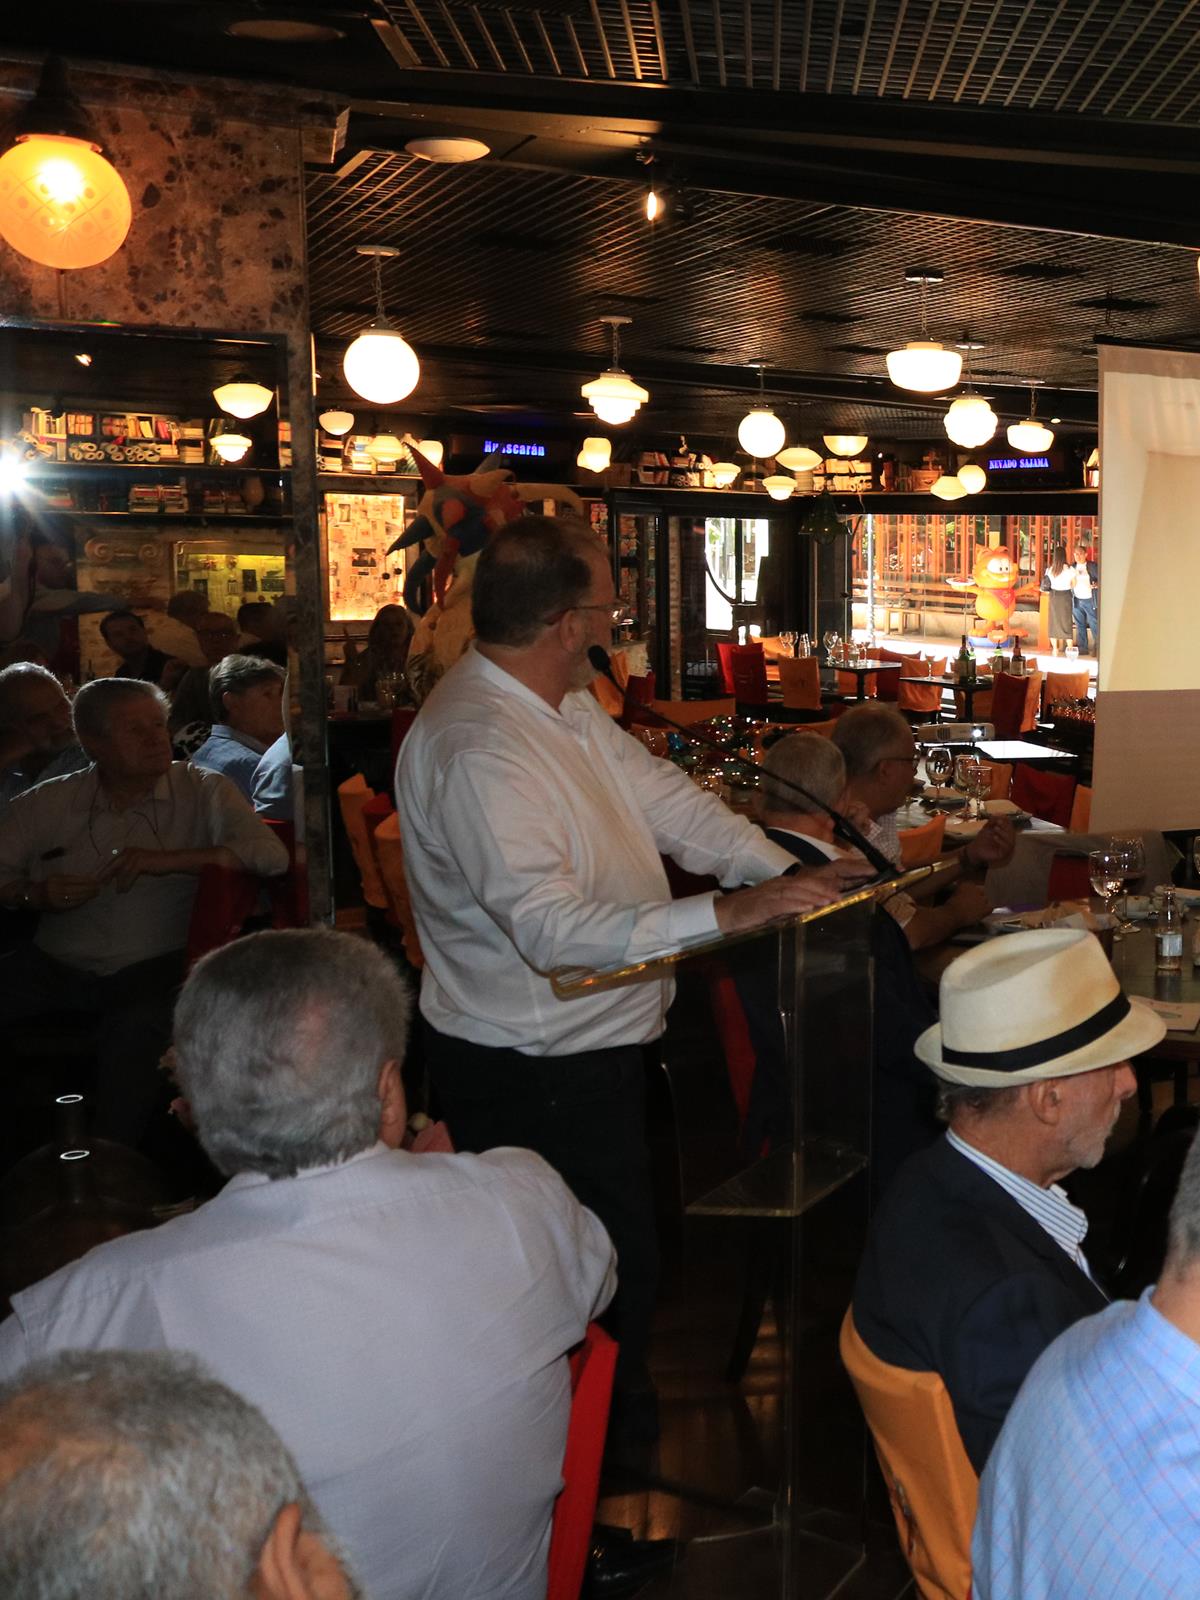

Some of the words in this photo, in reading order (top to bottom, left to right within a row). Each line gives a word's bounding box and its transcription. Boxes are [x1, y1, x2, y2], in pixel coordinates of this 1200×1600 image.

[484, 440, 545, 457] Huscarán
[988, 459, 1018, 470] NEVADO
[1019, 458, 1049, 469] SAJAMA
